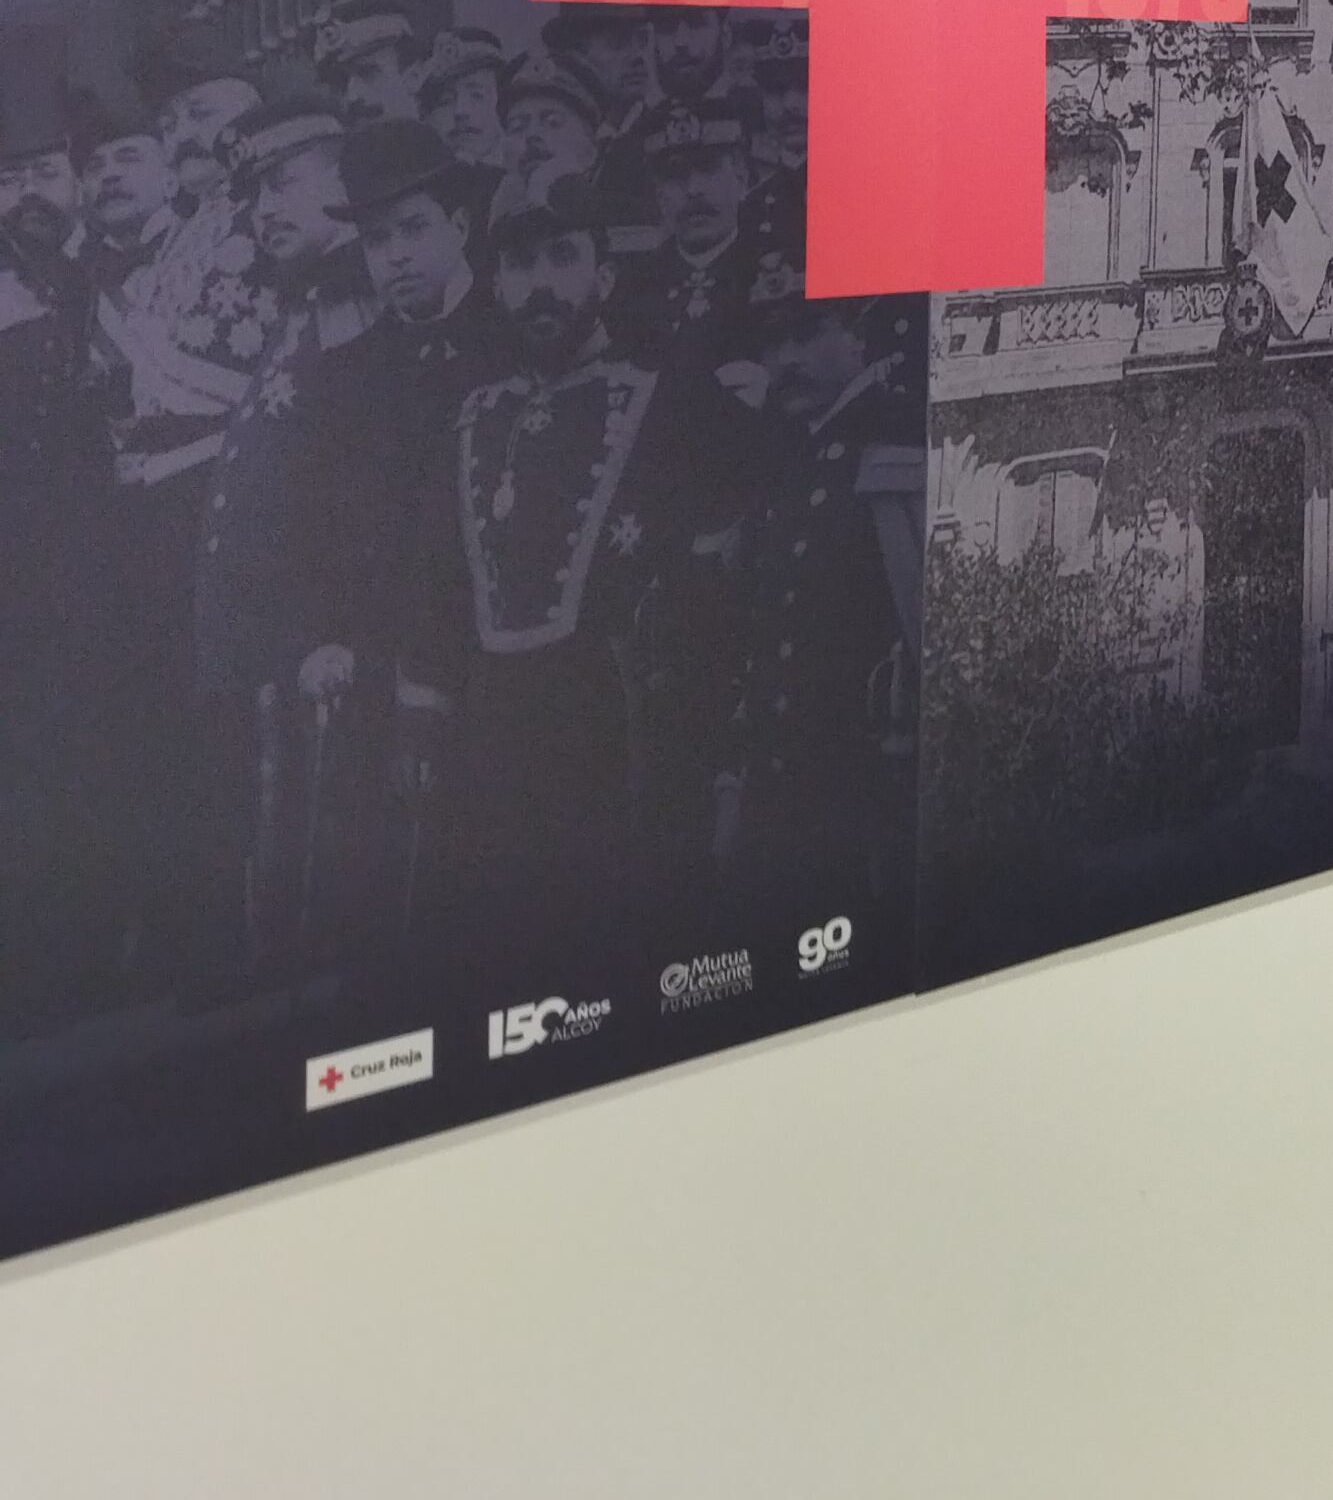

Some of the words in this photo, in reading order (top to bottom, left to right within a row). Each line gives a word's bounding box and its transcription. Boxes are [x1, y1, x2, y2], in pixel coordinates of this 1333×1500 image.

[798, 916, 852, 972] 90
[692, 948, 750, 977] Mutua
[689, 963, 752, 992] Levante
[564, 998, 611, 1024] AÑOS
[551, 1017, 602, 1044] ALCOY
[350, 1062, 385, 1079] Cruz
[389, 1048, 422, 1070] Roja
